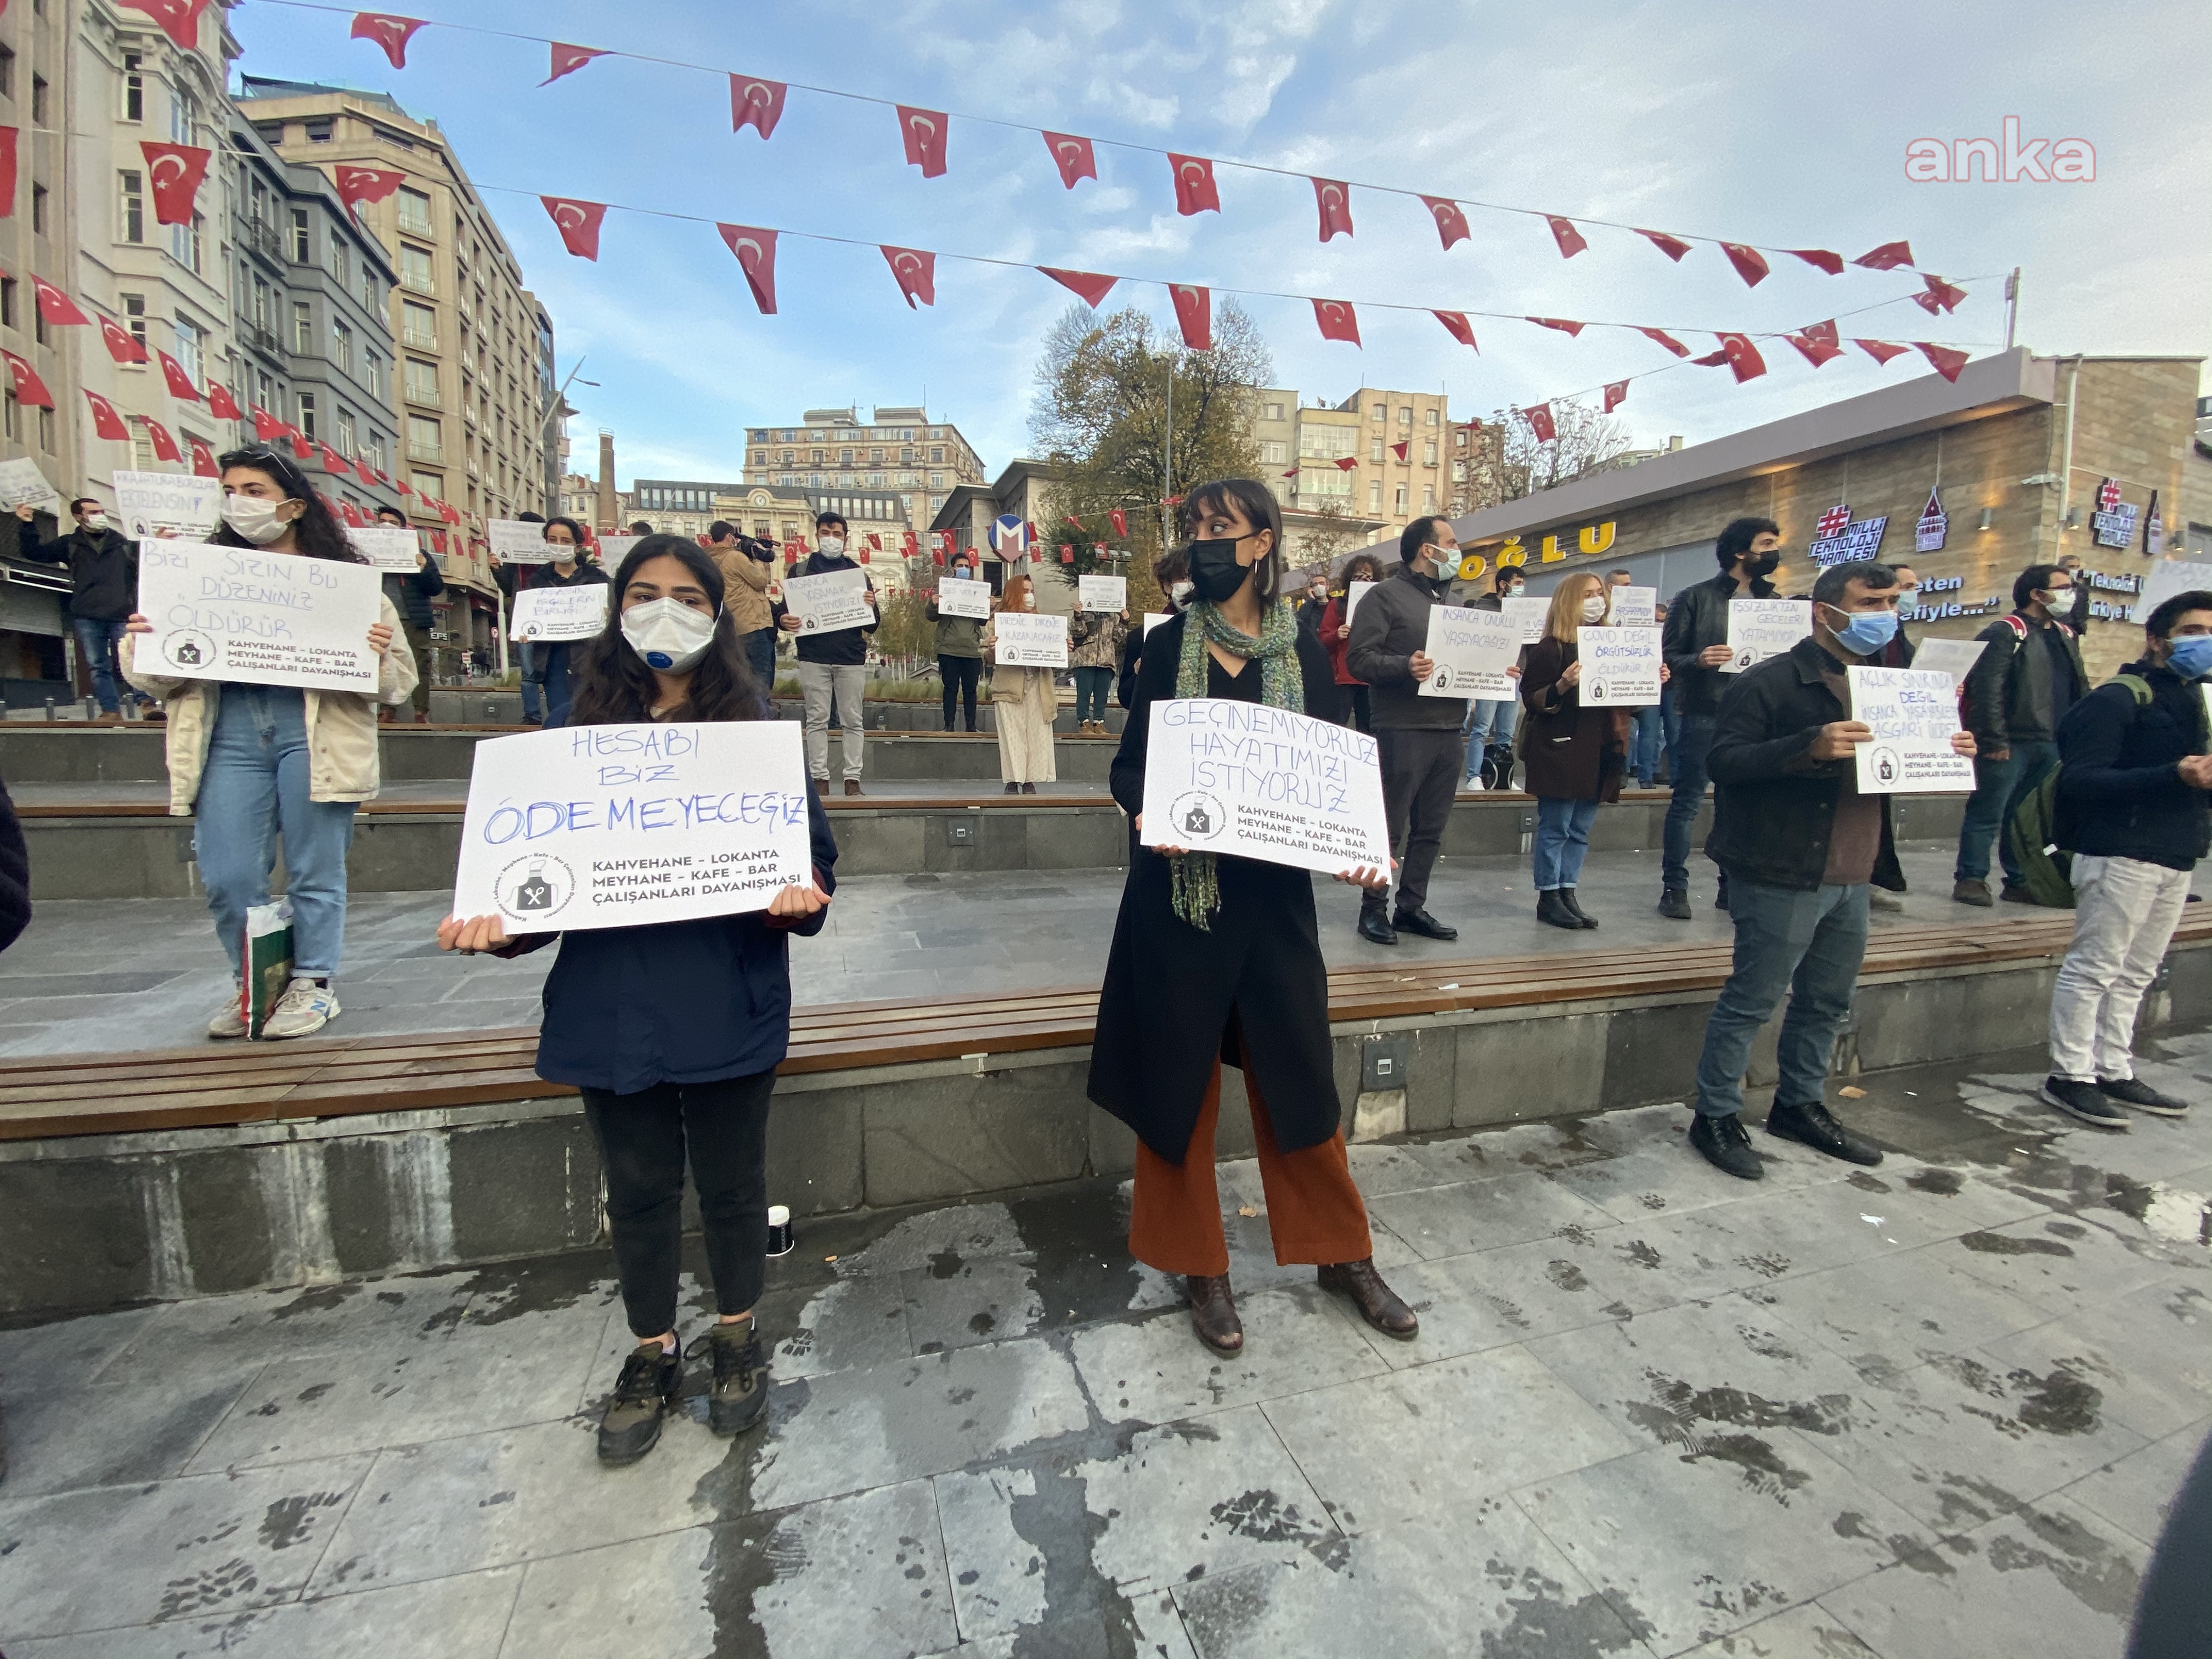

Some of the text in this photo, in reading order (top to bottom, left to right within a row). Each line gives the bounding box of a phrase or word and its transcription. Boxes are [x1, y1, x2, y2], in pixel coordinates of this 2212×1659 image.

[1458, 521, 1617, 580] OĞLU
[309, 565, 338, 589] BU
[1915, 576, 1963, 593] eten
[228, 640, 297, 653] KAHVEHANE
[309, 647, 358, 658] LOKANTA
[1584, 630, 1616, 643] COVID
[228, 650, 282, 662] MEYHANE
[295, 656, 321, 664] KAFE
[334, 659, 356, 668] BAR
[228, 660, 371, 679] ÇALIŞANLARI DAYANIŞMASI
[572, 728, 700, 760] HESABI
[1163, 701, 1379, 766] GEÇİNEMİYORUZ
[1190, 732, 1348, 784] HAYATIMIZI
[1238, 804, 1306, 825] KAHVEHANE
[1319, 820, 1367, 838] LOKANTA
[1238, 817, 1292, 834] MEYHANE
[1305, 830, 1333, 842] KAFE
[1345, 838, 1367, 849] BAR
[592, 856, 692, 872] KAHVEHANE
[711, 849, 780, 864] LOKANTA
[1237, 829, 1383, 865] ÇALIŞANLARI DAYANIŞMASI
[592, 873, 672, 888] MEYHANE
[691, 868, 730, 881] KAFE
[748, 863, 778, 875] BAR
[592, 873, 801, 907] ÇALIŞANLARI DAYANIŞMASI
